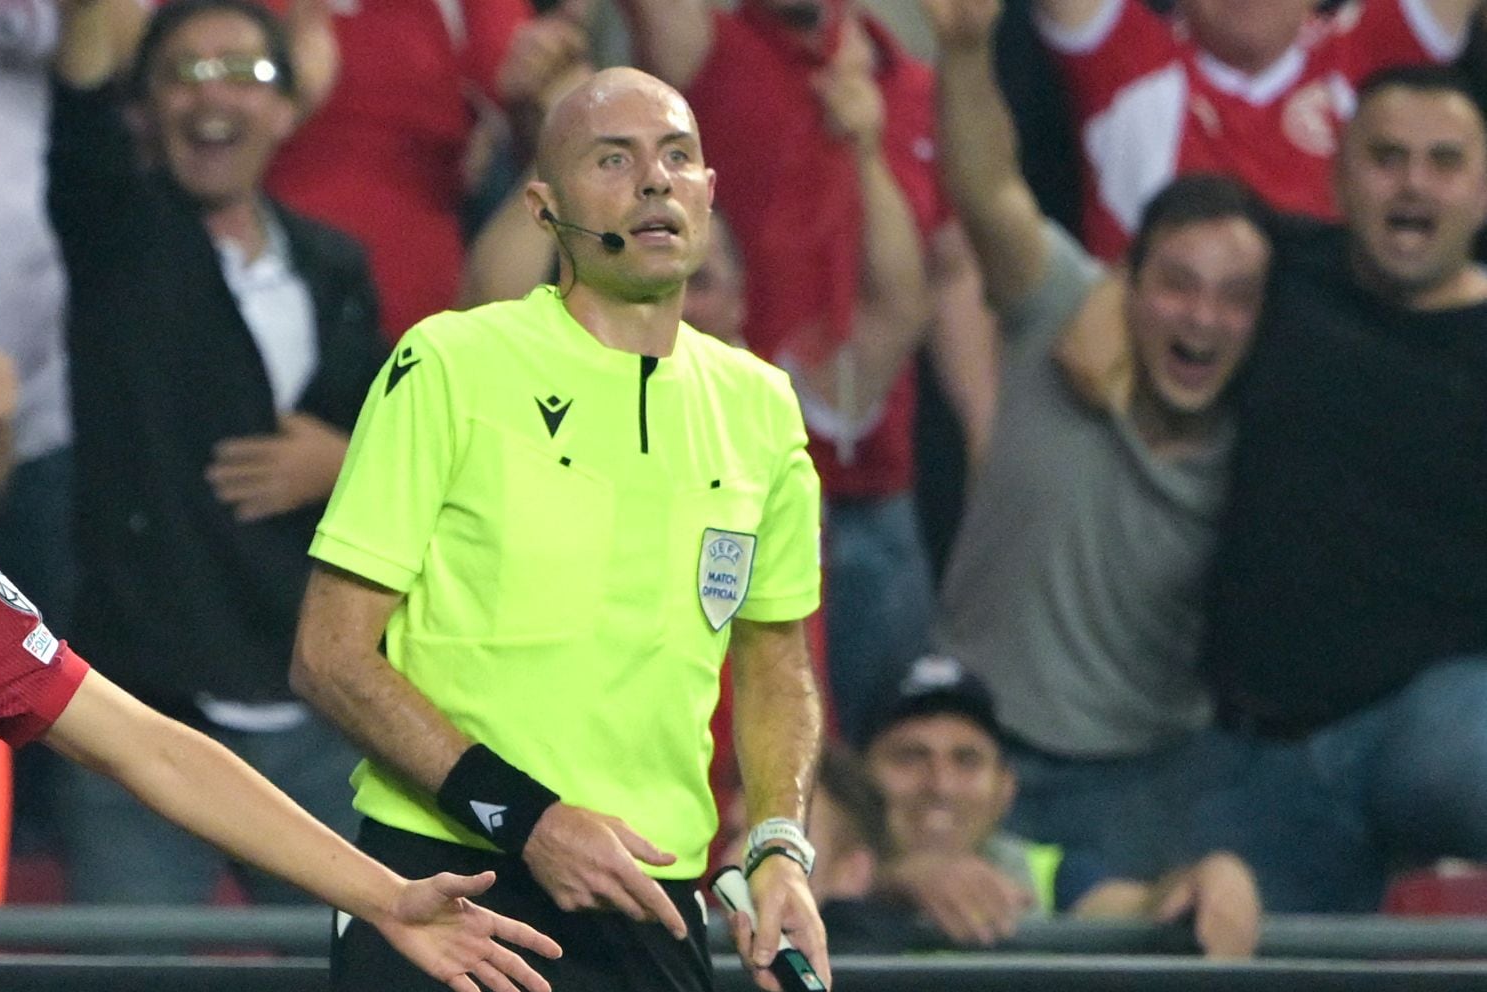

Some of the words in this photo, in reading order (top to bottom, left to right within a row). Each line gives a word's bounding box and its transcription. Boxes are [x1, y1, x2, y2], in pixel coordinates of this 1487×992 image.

[709, 541, 740, 562] UEFA
[709, 571, 737, 584] MATCH
[702, 586, 737, 600] OFFICIAL
